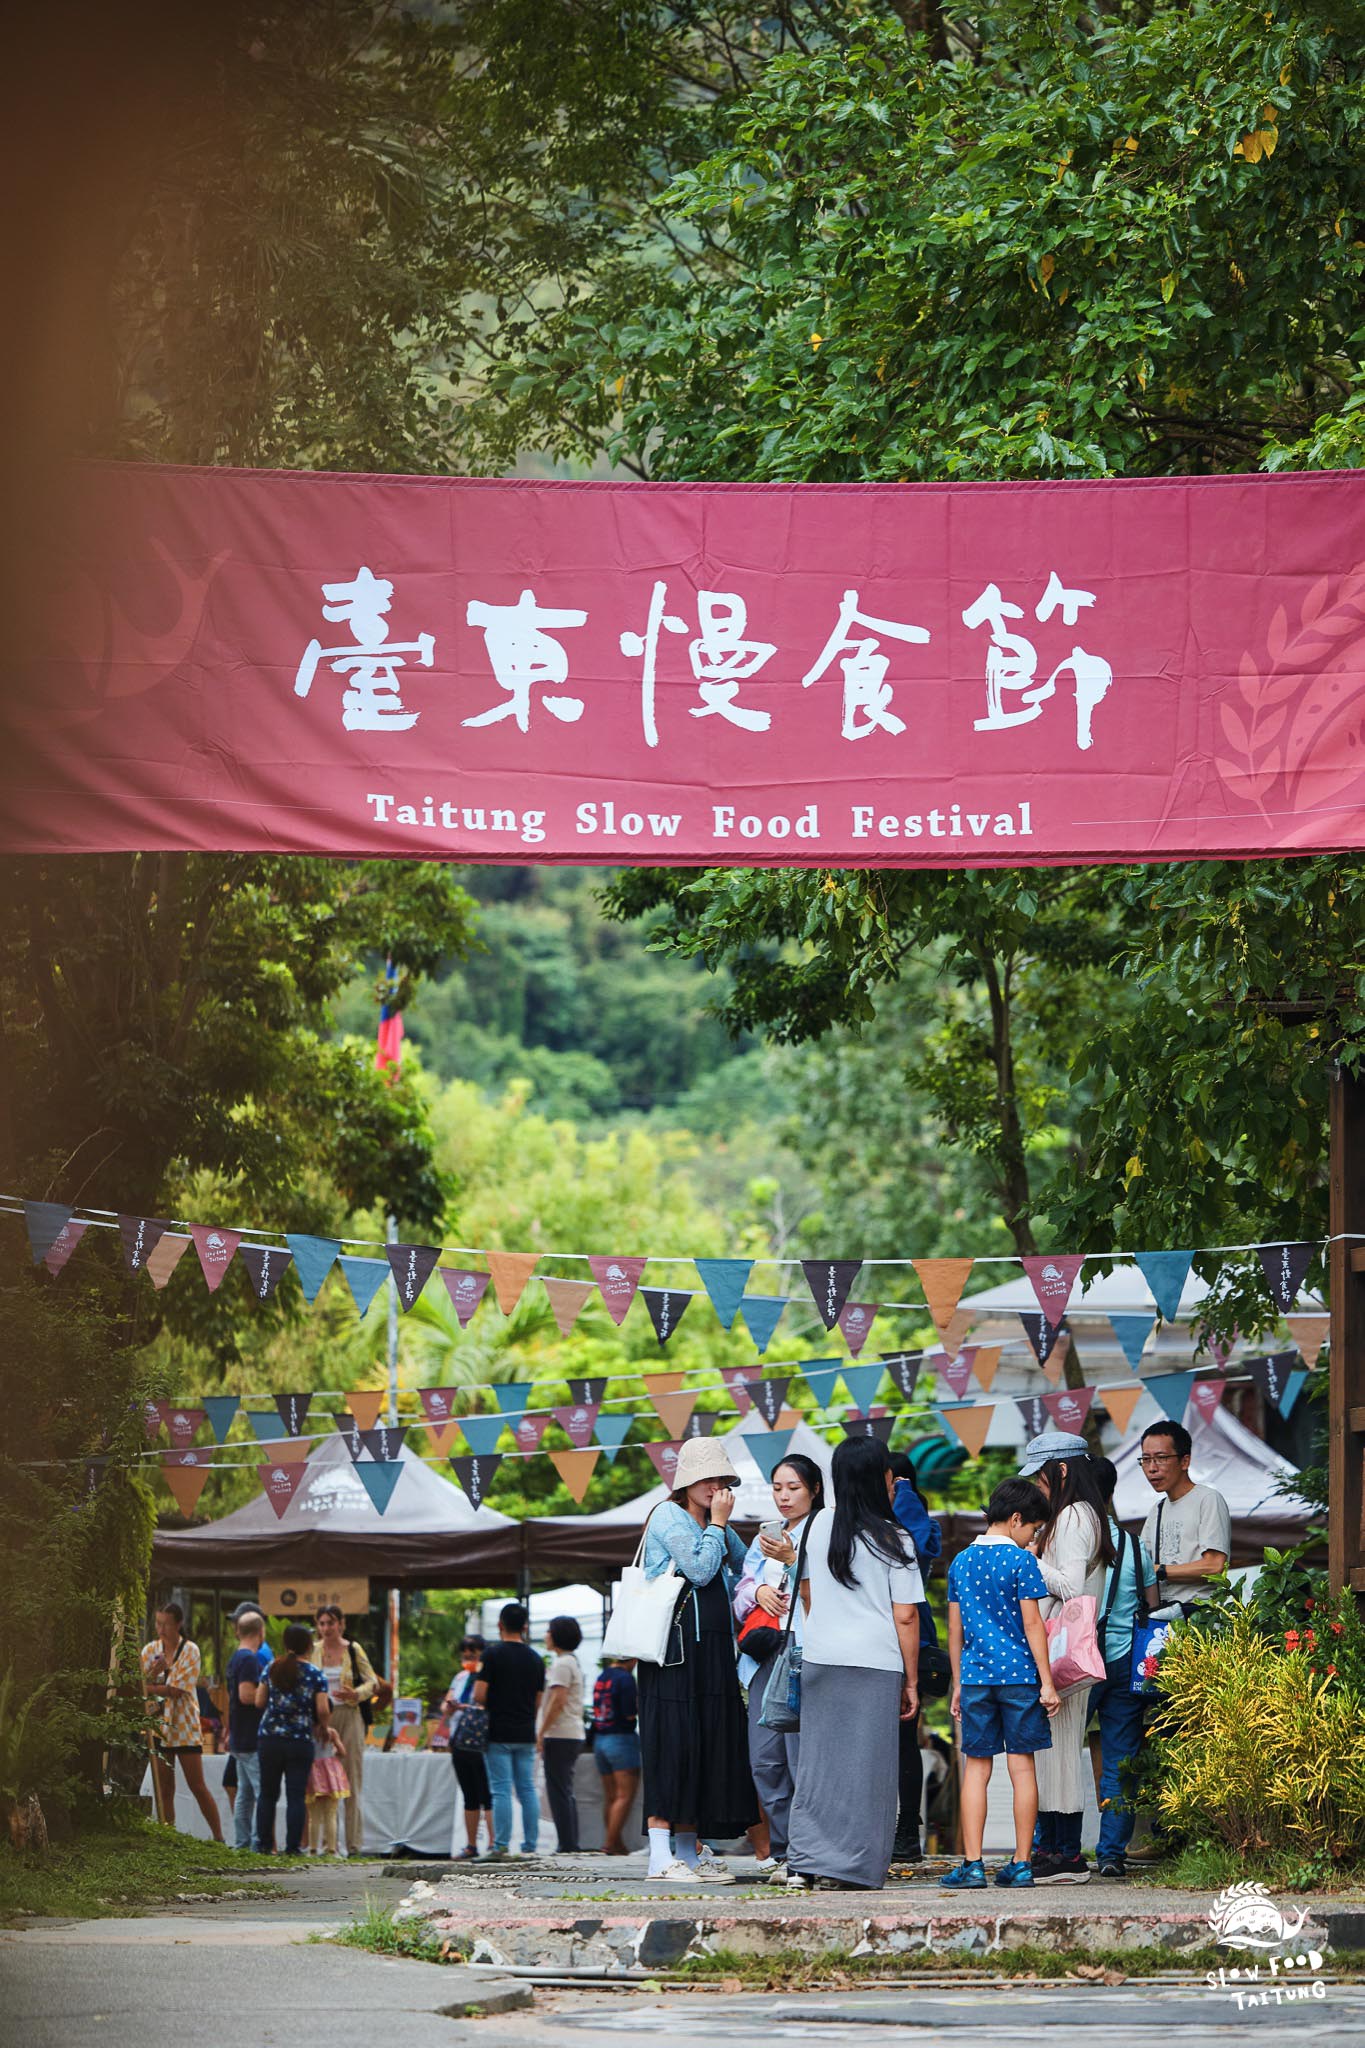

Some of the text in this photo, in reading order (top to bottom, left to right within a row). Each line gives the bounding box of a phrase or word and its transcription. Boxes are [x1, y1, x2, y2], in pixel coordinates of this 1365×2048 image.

[294, 566, 1113, 750] 臺東慢食節
[366, 793, 1034, 843] Taitung Slow Food Festival
